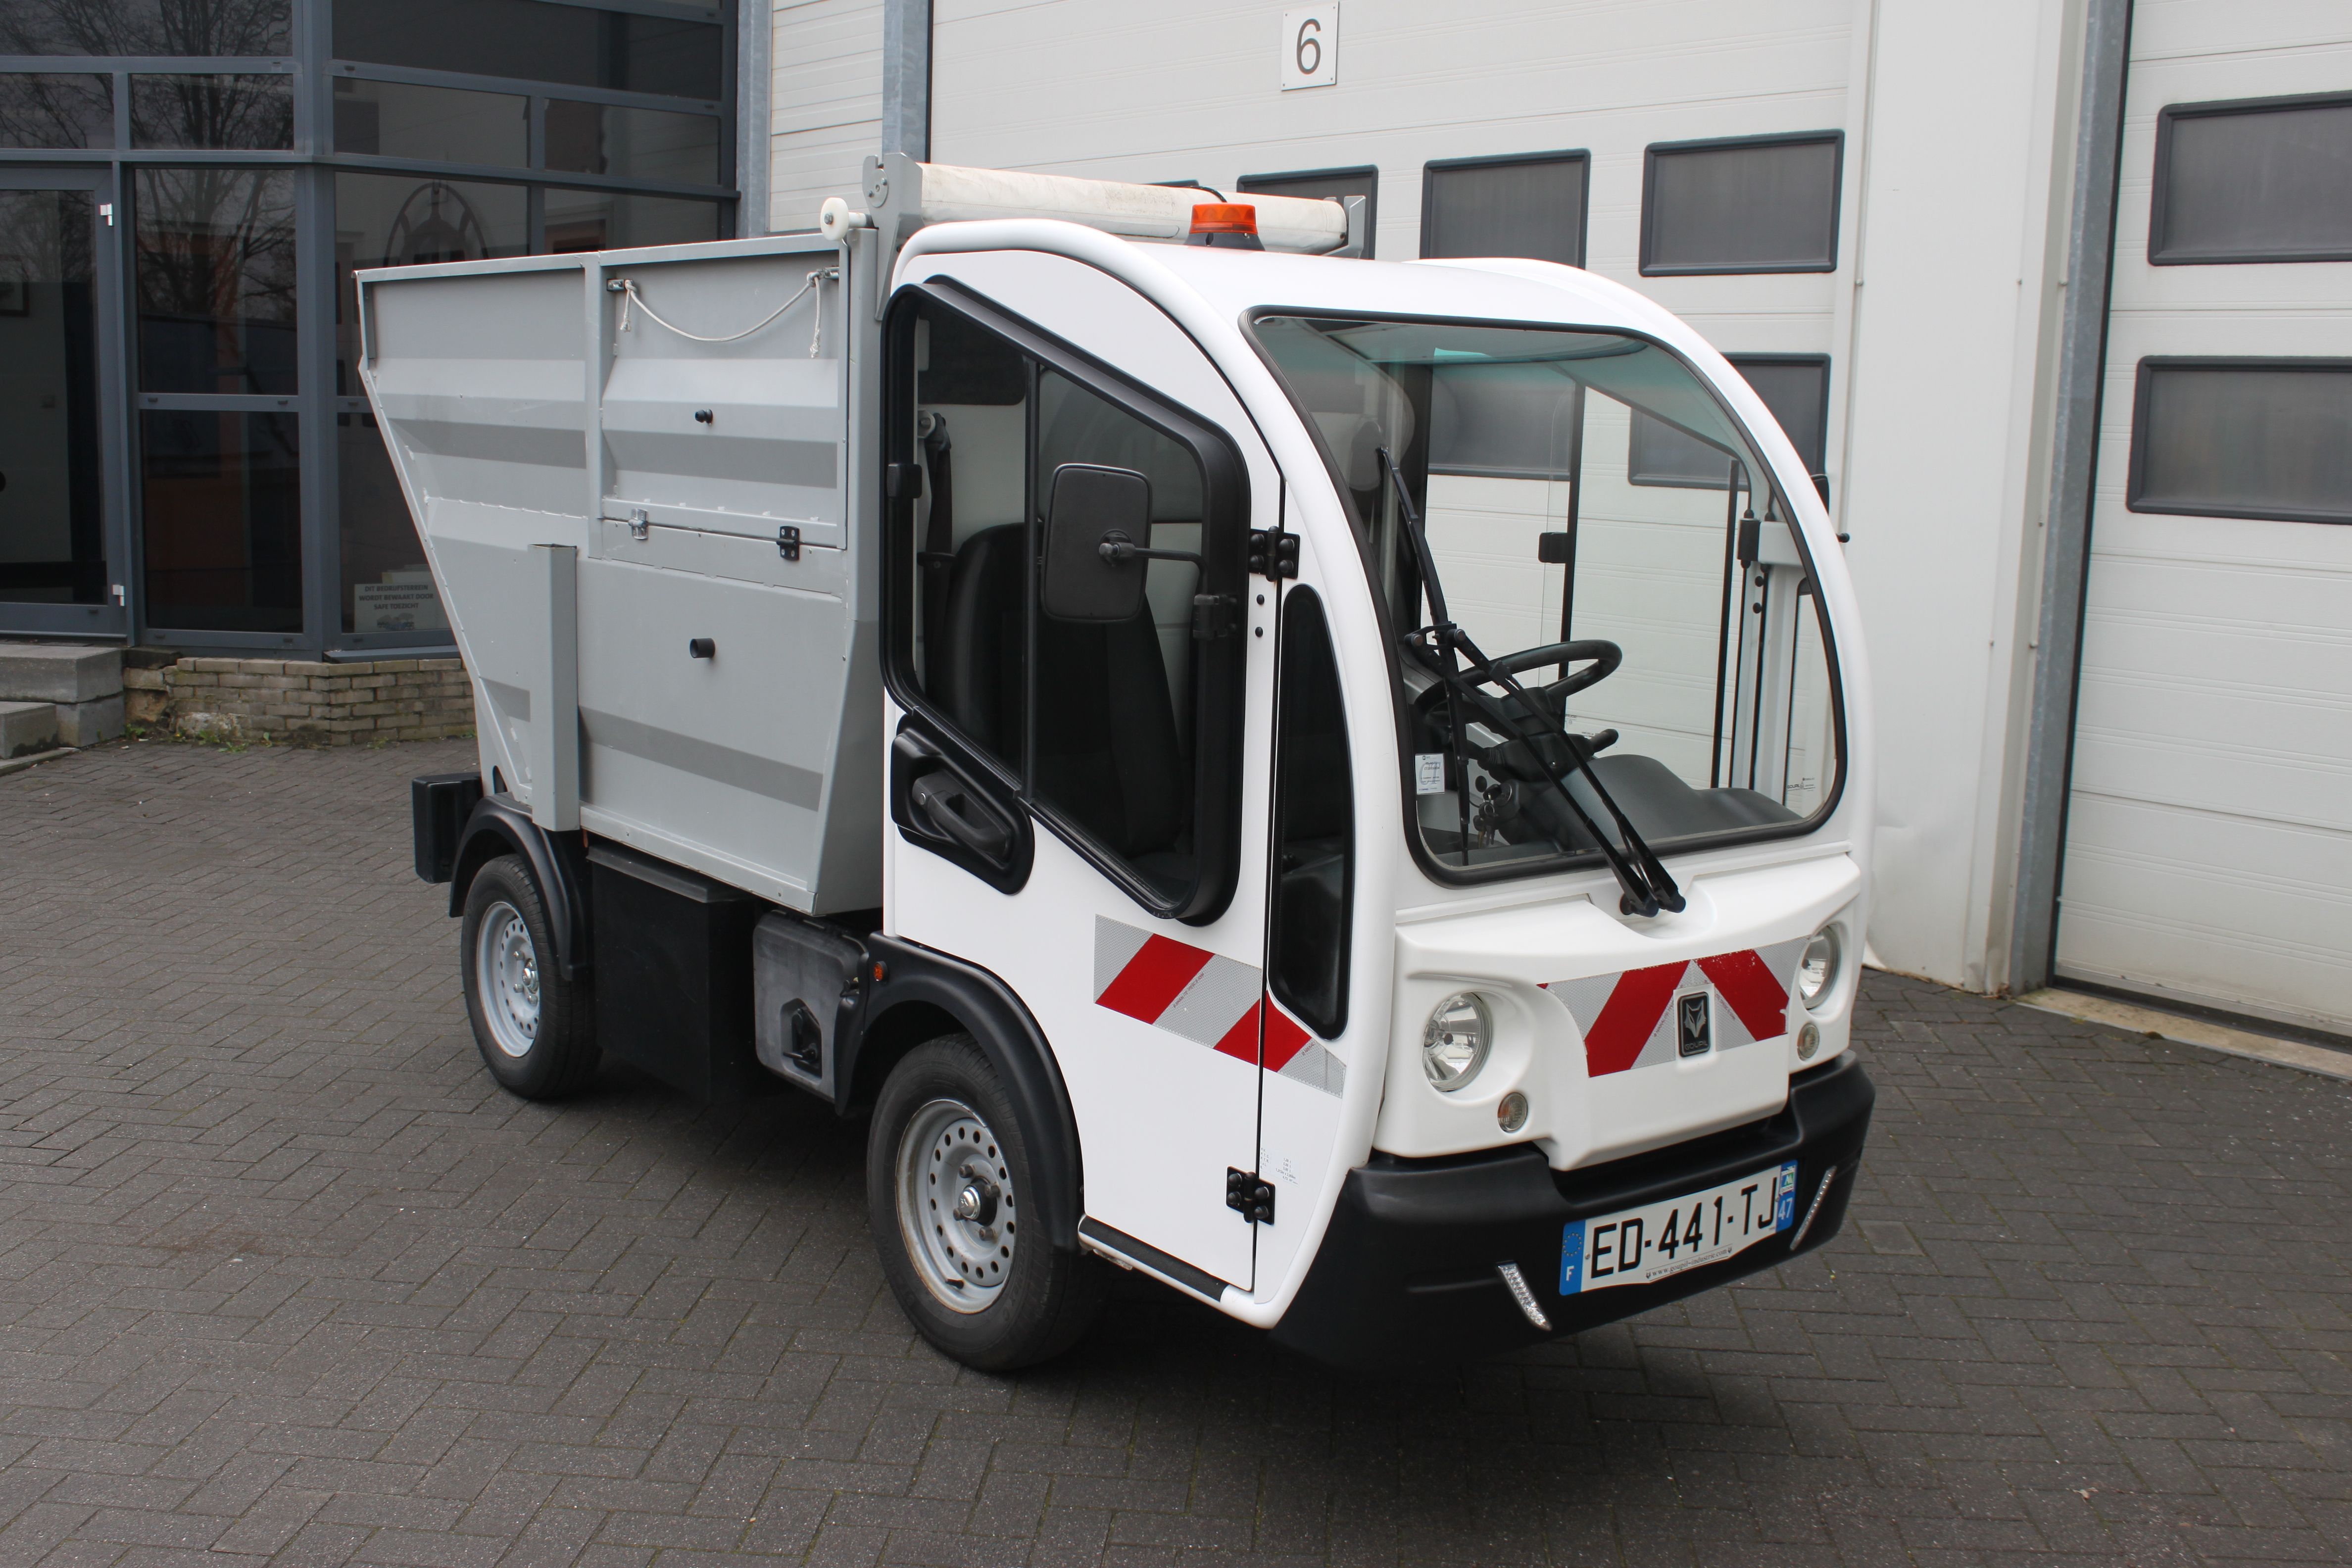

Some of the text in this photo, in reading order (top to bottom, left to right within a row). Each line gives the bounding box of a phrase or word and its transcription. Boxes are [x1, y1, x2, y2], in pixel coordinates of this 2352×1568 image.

[1296, 18, 1321, 75] 6
[1684, 1040, 1708, 1050] GOUPIL
[1778, 1197, 1793, 1220] 47
[1591, 1176, 1777, 1278] ED-441-TJ
[1652, 1248, 1727, 1274] www.goupil-industrie.com
[1566, 1266, 1574, 1281] F
